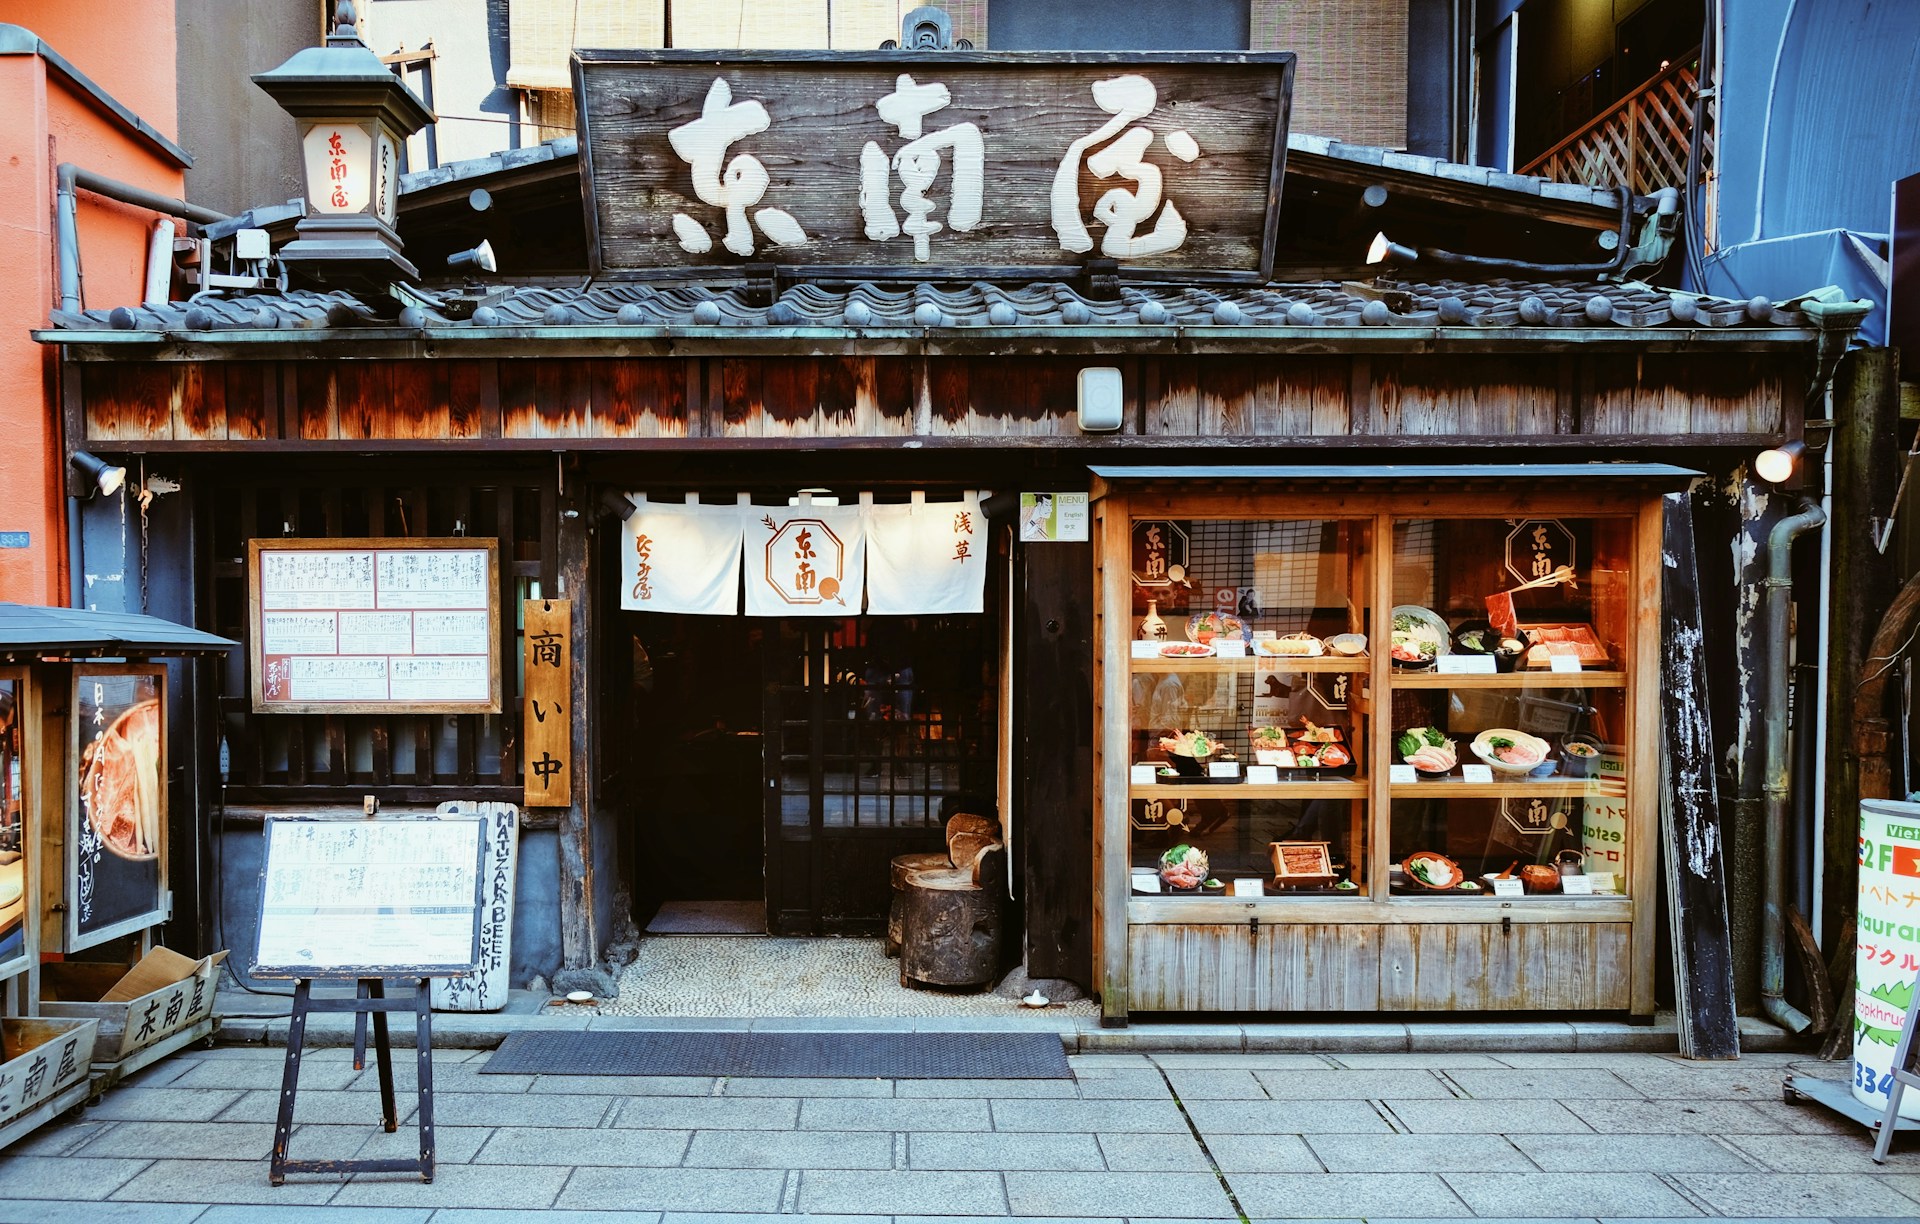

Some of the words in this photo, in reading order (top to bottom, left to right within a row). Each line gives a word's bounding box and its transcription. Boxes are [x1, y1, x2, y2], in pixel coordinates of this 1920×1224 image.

[1058, 495, 1085, 504] MENU
[1064, 511, 1084, 519] English
[952, 511, 975, 565] 浅草
[529, 629, 564, 790] 商い中
[491, 810, 514, 906] MATUZAKA
[477, 922, 492, 1009] SUKIYAKI
[491, 907, 506, 971] BEEF
